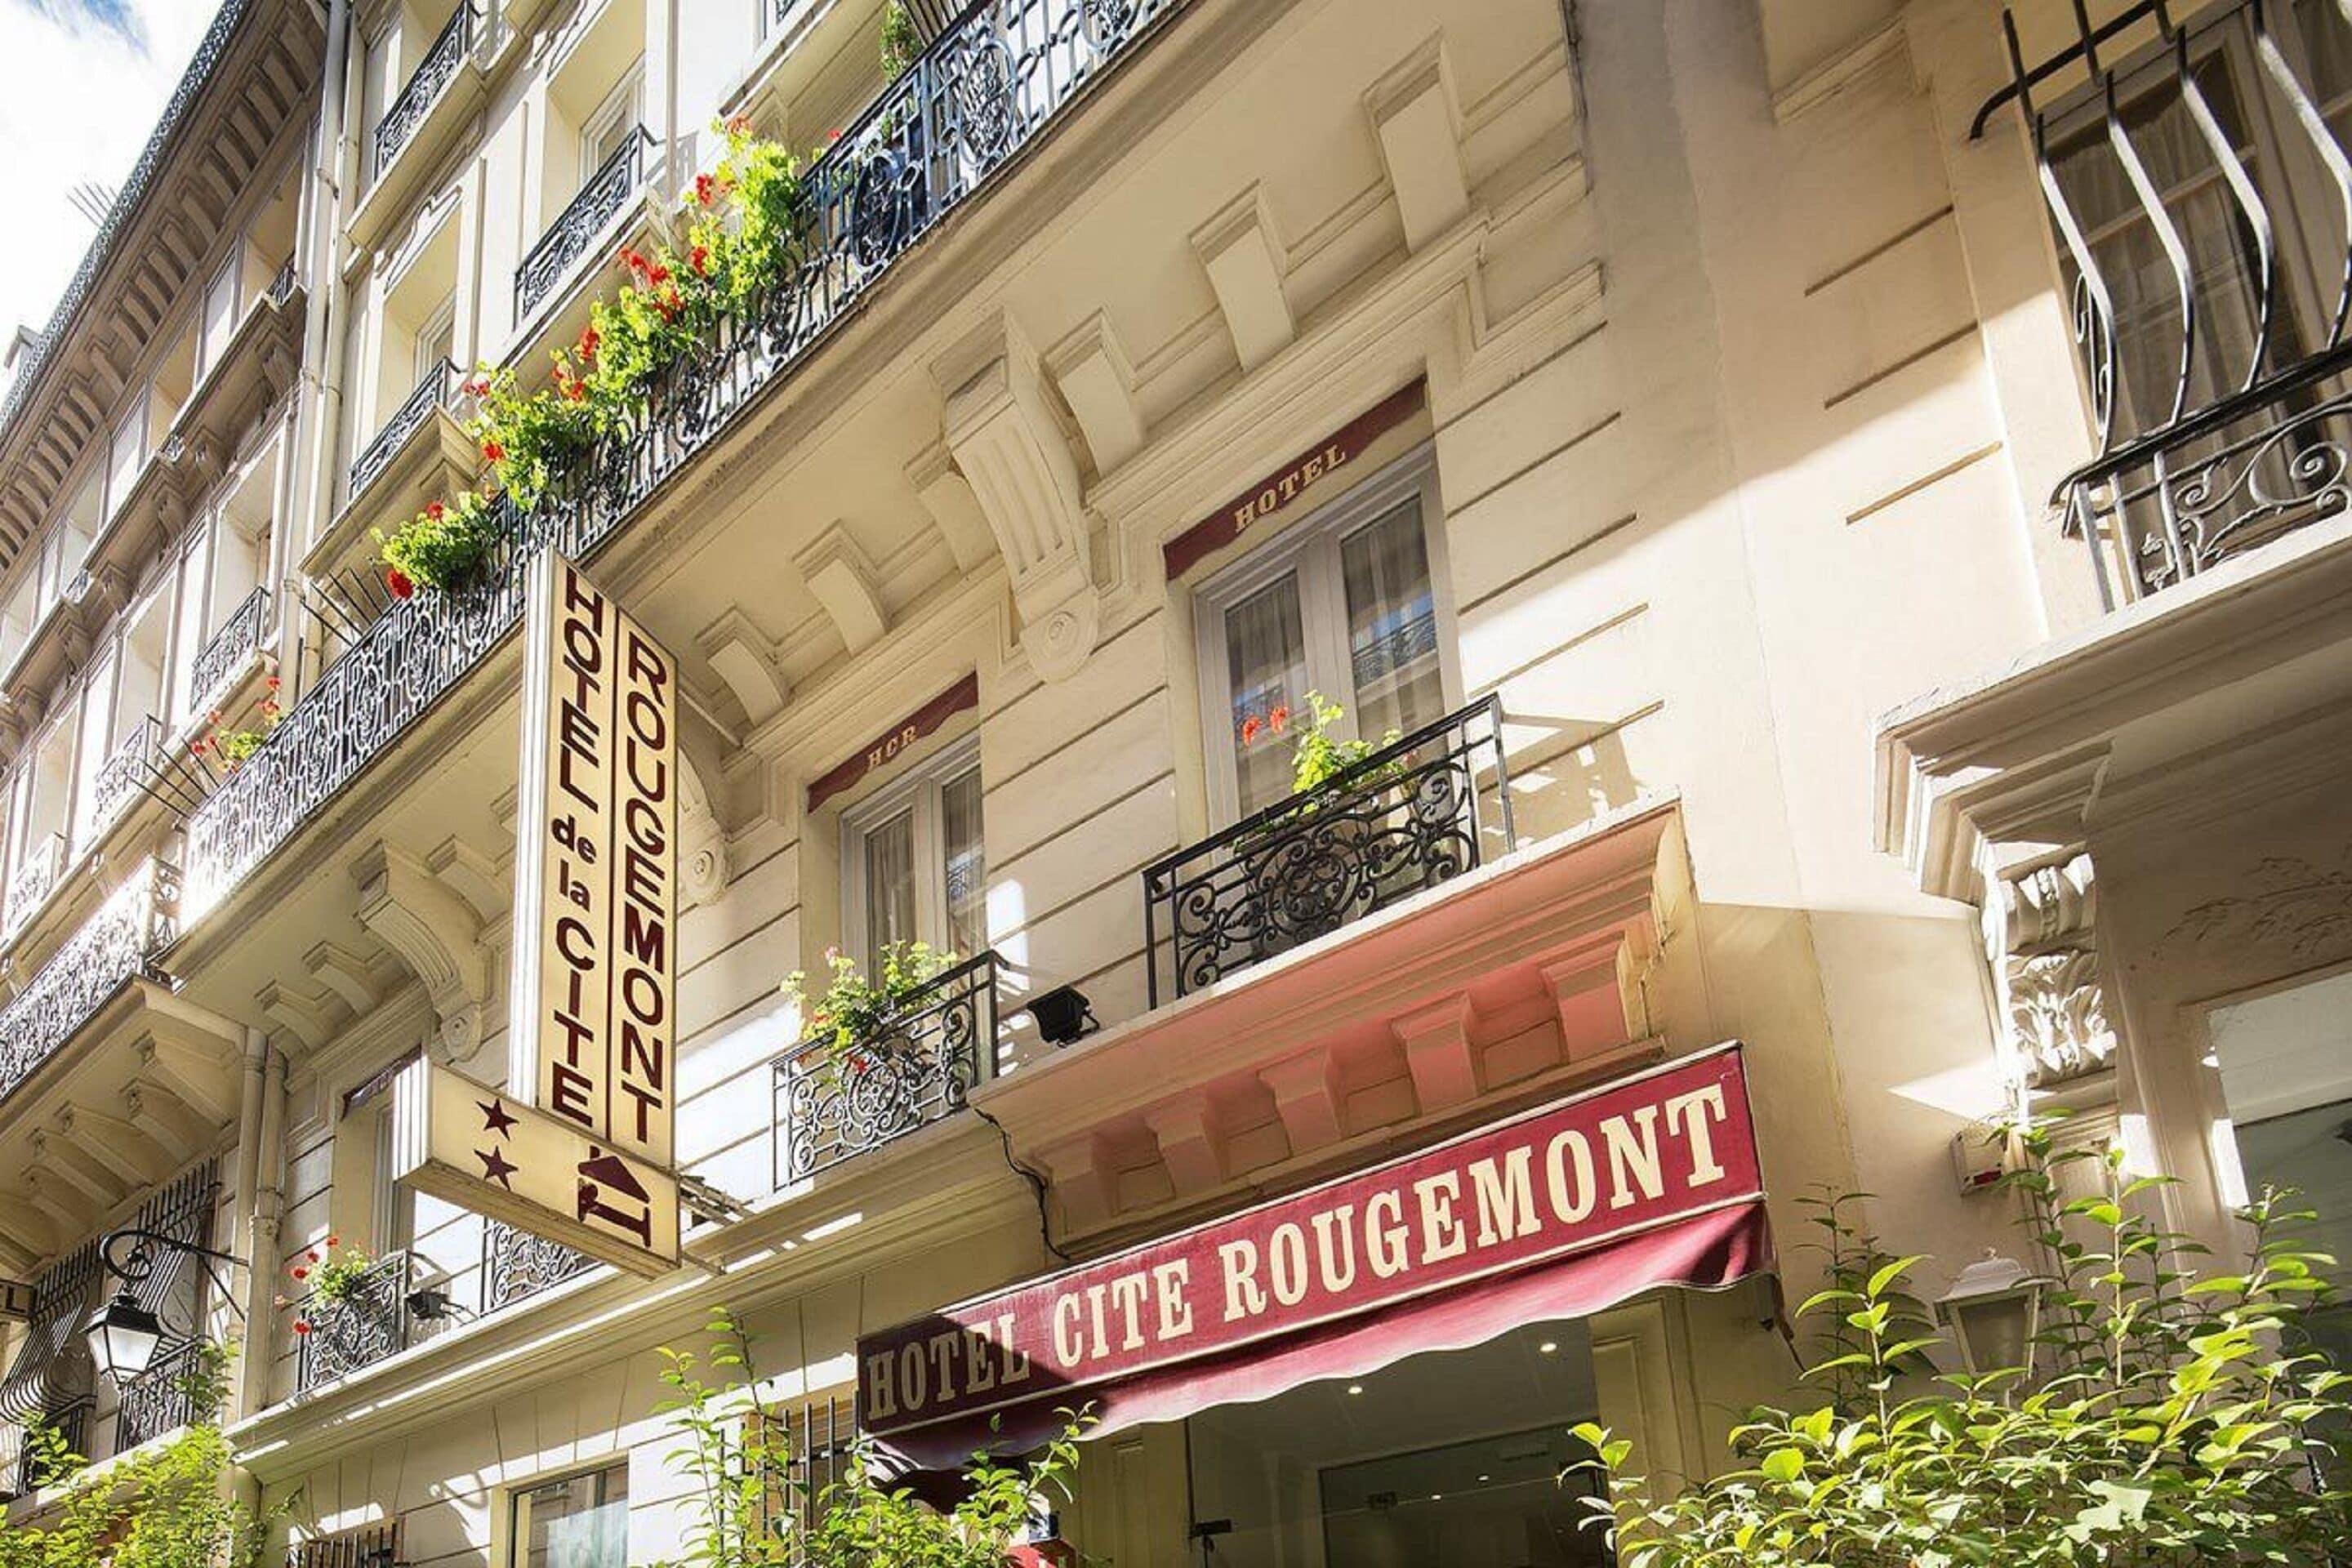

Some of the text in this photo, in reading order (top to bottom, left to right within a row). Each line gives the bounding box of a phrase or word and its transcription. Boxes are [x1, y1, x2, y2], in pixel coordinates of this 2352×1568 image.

[1234, 444, 1346, 533] HOTEL
[550, 565, 604, 1128] HOTEL de la CITE
[621, 630, 667, 1144] ROUGEMONT
[867, 724, 917, 769] HCR
[867, 1083, 1727, 1421] HOTEL CITE ROUGEMONT
